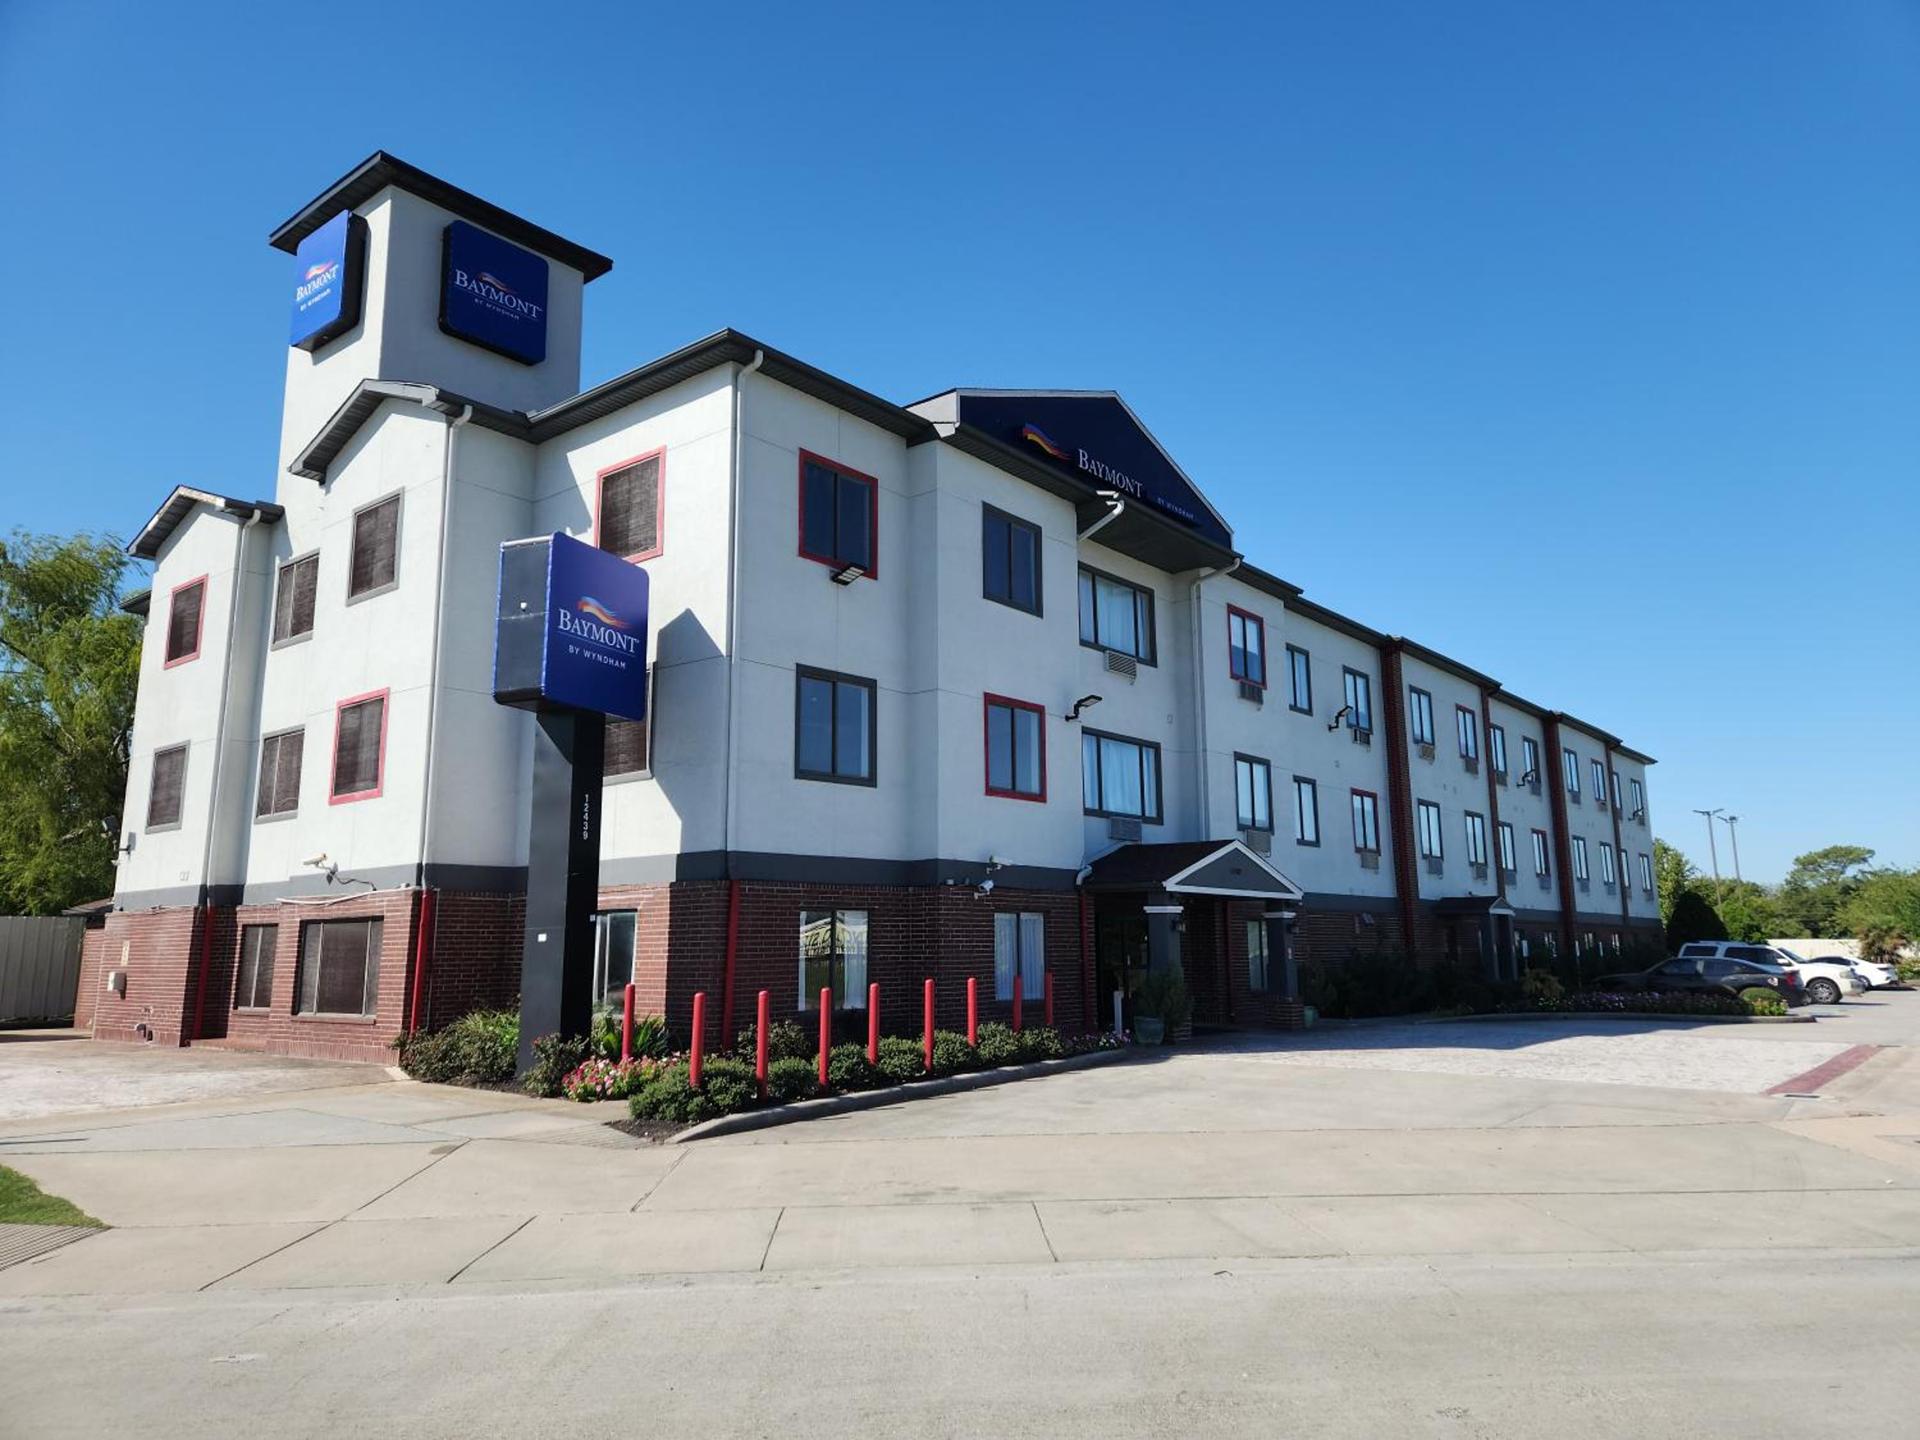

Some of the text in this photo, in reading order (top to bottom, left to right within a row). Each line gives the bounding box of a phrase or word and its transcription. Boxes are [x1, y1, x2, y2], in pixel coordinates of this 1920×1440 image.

[455, 268, 543, 318] BAYMONT
[1078, 448, 1143, 498] BAYMONT
[558, 608, 639, 653] BAYMONT
[568, 644, 627, 669] BY WYNDHAM
[582, 793, 590, 840] 12439
